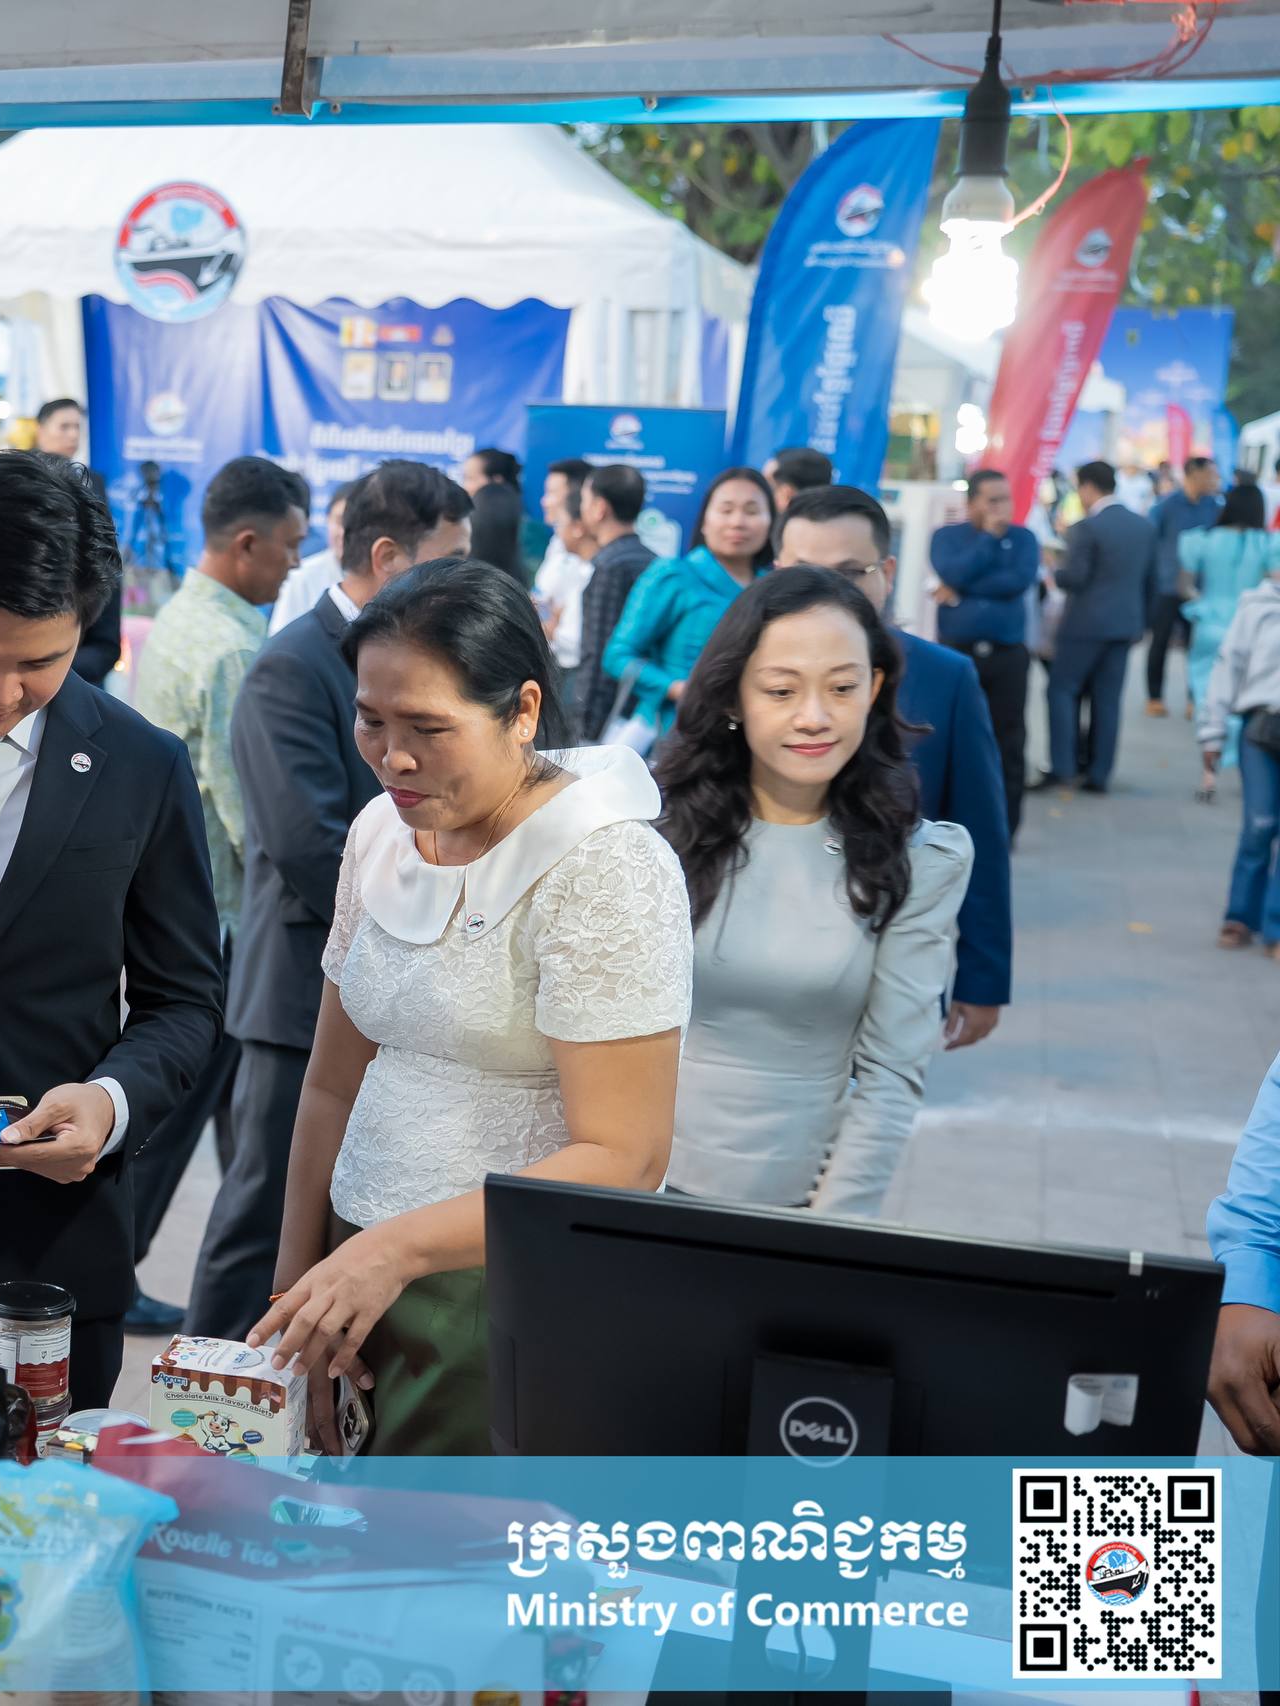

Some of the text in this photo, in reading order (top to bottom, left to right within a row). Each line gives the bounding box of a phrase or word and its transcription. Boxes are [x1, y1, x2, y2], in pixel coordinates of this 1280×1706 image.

[204, 1394, 219, 1402] Milk
[789, 1418, 850, 1445] DELL
[235, 1537, 279, 1568] Tea
